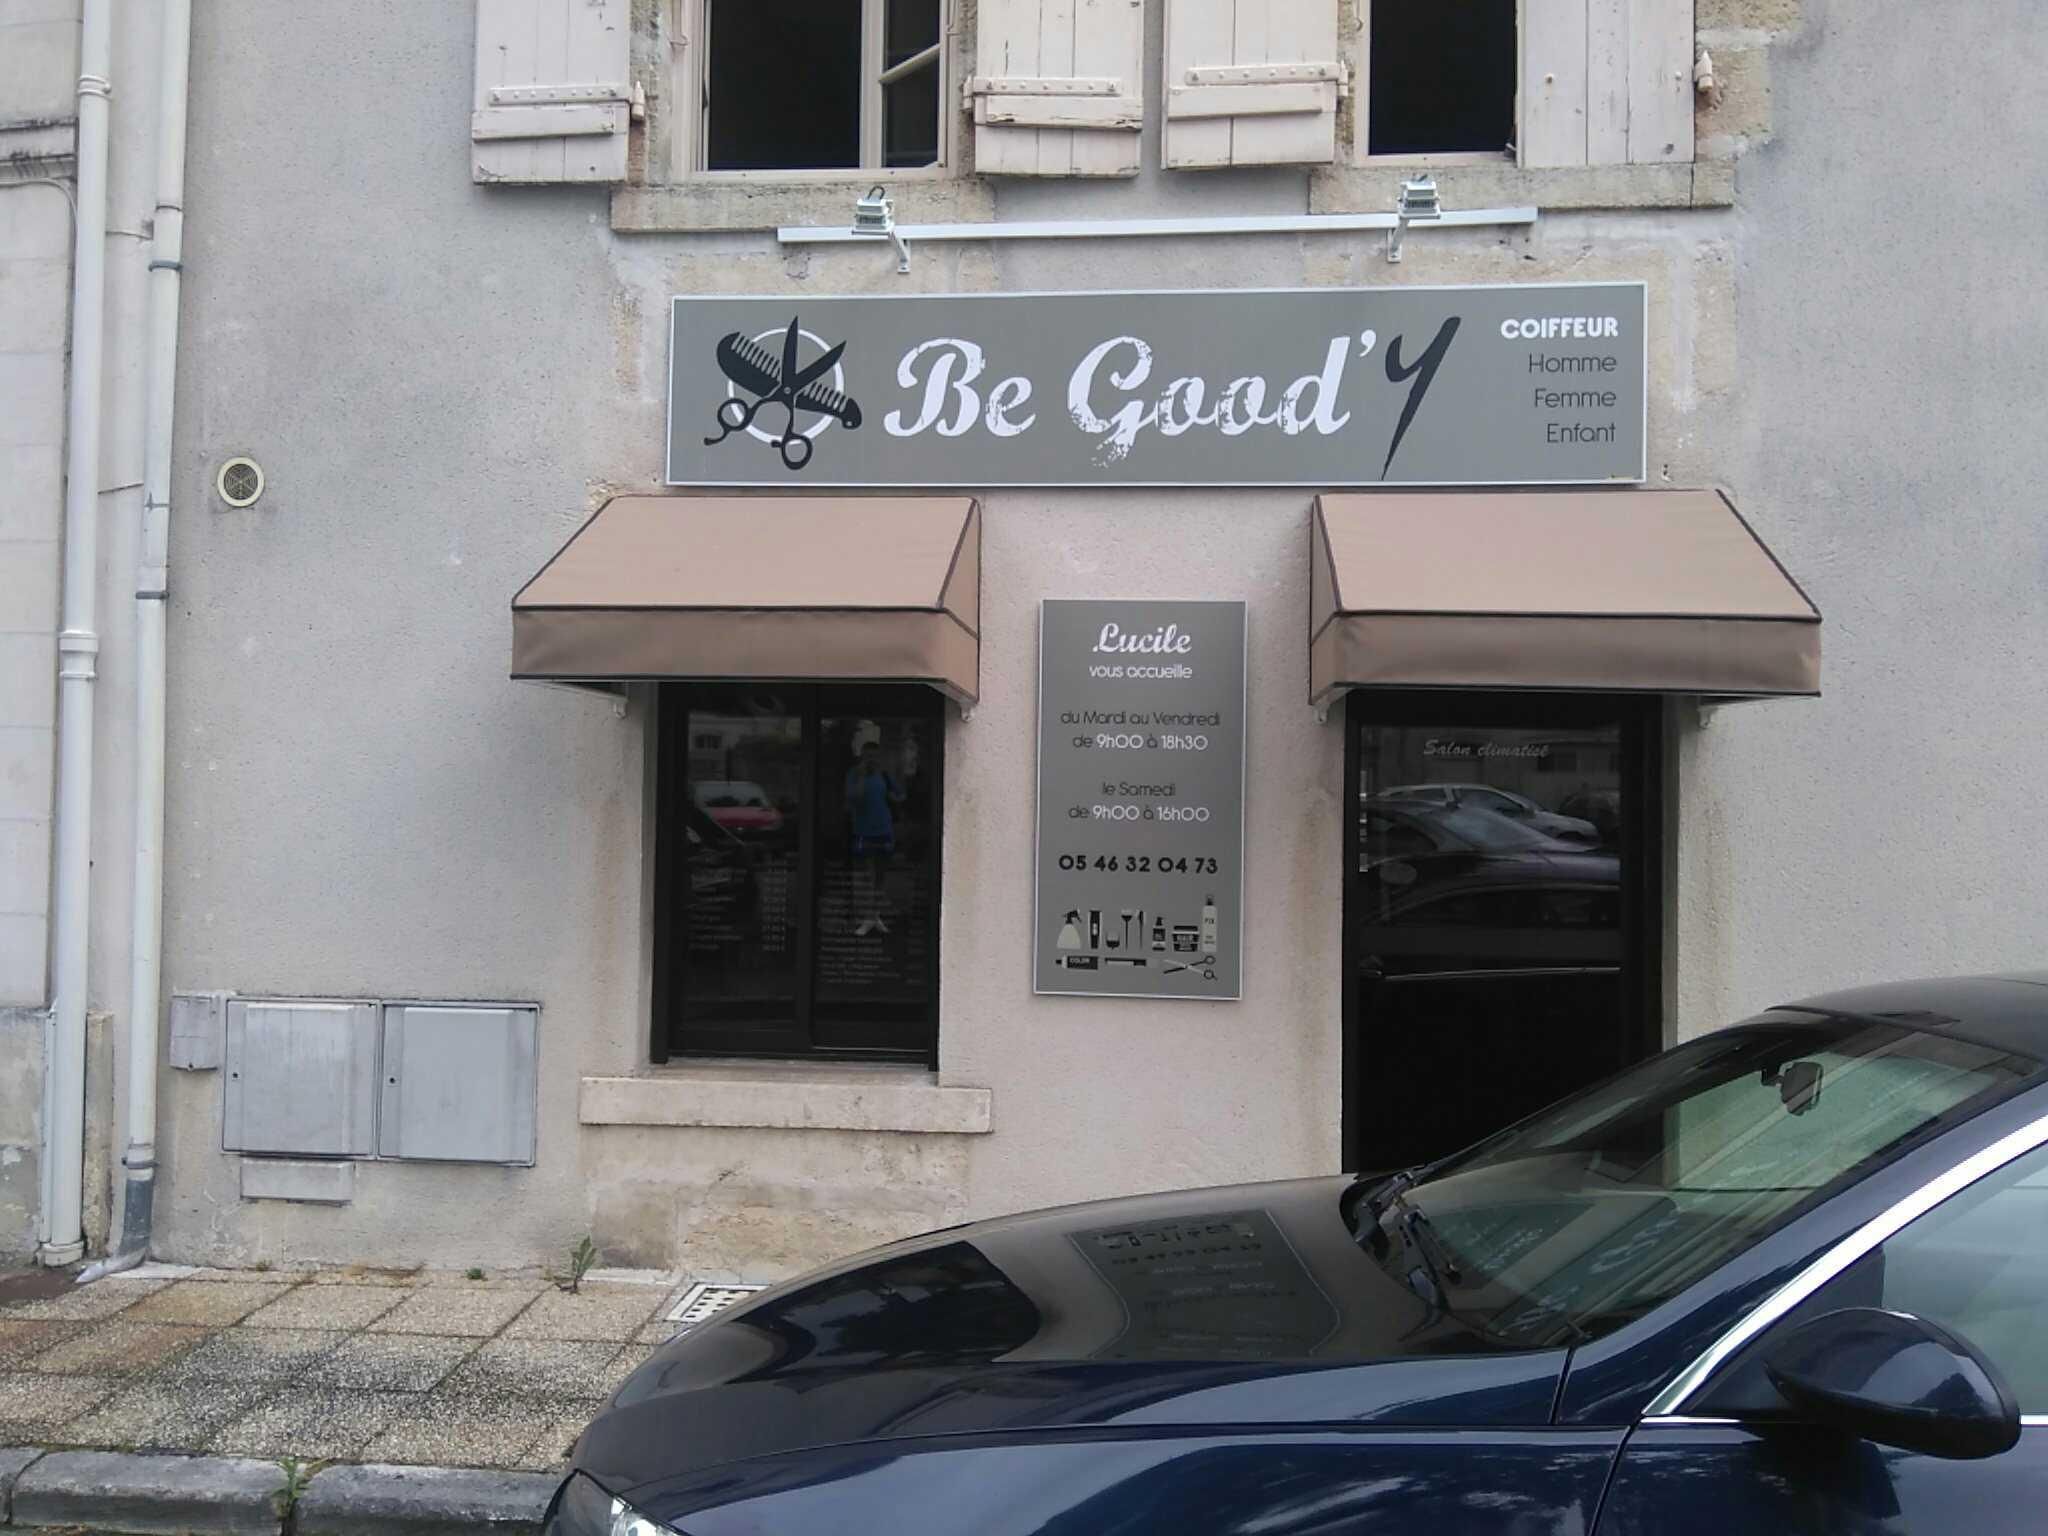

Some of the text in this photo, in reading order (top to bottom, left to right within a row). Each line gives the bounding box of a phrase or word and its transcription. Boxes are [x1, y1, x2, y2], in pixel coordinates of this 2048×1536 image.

[1500, 316, 1619, 340] COIFFEUR
[1528, 353, 1618, 375] Homme
[883, 338, 1036, 437] Be
[1533, 388, 1617, 409] Femme
[1546, 422, 1617, 444] Enfant
[1092, 622, 1192, 654] Lucile
[1088, 663, 1193, 679] vous accueille
[1060, 710, 1220, 727] du Mardi au Vendredi
[1072, 733, 1209, 751] de 9h00 à 18h30
[1423, 738, 1471, 756] Salon
[1102, 781, 1176, 797] le Samedi
[1068, 804, 1210, 822] de 9h00 à 16h00
[1058, 854, 1218, 875] 05 46 32 04 73
